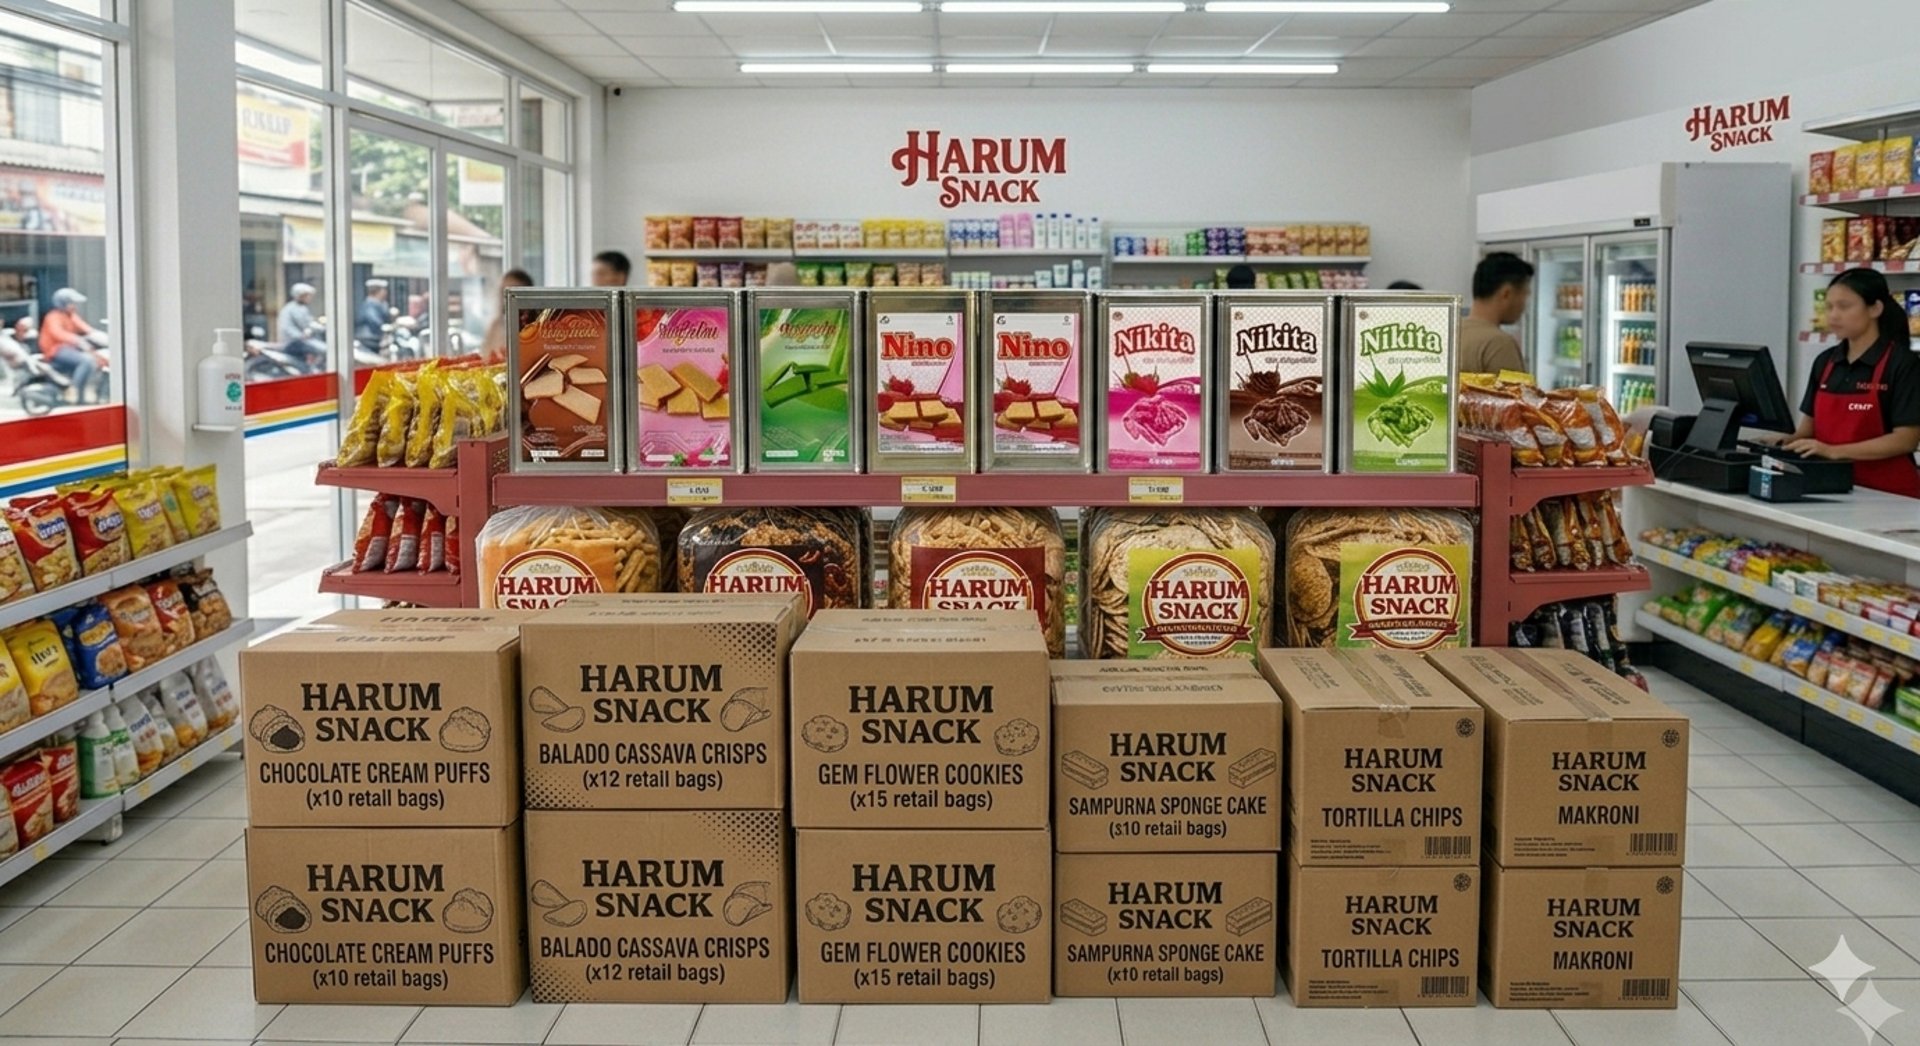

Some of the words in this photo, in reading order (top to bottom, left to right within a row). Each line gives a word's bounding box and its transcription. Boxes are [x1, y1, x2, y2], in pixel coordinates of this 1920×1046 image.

[1685, 95, 1790, 142] HARUM
[1711, 125, 1773, 152] SNACK
[892, 131, 1067, 187] HARUM
[939, 175, 1041, 208] SNACK
[881, 331, 955, 360] Nino
[997, 331, 1072, 360] Nino
[1115, 322, 1196, 356] Nikita
[1236, 322, 1317, 356] Nikita
[1361, 321, 1443, 356] Nikita
[498, 576, 596, 596] HARUM
[709, 575, 805, 593] HARUM
[929, 578, 1028, 598] HARUM
[1150, 580, 1248, 599] HARUM
[1362, 575, 1457, 595] HARUM
[506, 598, 568, 610] SNA
[1158, 602, 1239, 620] SNACK
[580, 665, 722, 692] HARUM
[301, 683, 442, 711] HARUM
[849, 686, 993, 713] HARUM
[594, 698, 711, 723] SNACK
[316, 717, 431, 742] SNACK
[862, 719, 981, 744] SNACK
[540, 743, 609, 764] BALADO
[616, 743, 696, 764] CASSAVA
[702, 743, 767, 764] CRISPS
[1110, 733, 1226, 756] HARUM
[1345, 748, 1442, 768] HARUM
[1552, 751, 1646, 770] HARUM
[260, 762, 361, 783] CHOCOLATE
[367, 762, 428, 783] CREAM
[435, 762, 490, 783] PUFFS
[583, 770, 619, 791] (x12
[676, 771, 722, 791] bags)
[819, 764, 857, 784] GEM
[865, 764, 938, 785] FLOWER
[946, 764, 1023, 785] COOKIES
[1121, 762, 1216, 782] SNACK
[1559, 774, 1639, 791] SNACK
[1352, 774, 1436, 792] SNACK
[307, 789, 342, 810] (x10
[398, 789, 444, 810] bags)
[851, 790, 887, 811] (x15
[945, 791, 992, 811] bags)
[1070, 797, 1156, 815] SAMPURNA
[1161, 797, 1222, 815] SPONGE
[1227, 796, 1266, 814] CAKE
[1322, 808, 1404, 827] TORTILLA
[1411, 807, 1462, 827] CHIPS
[1559, 805, 1639, 824] MAKRONI
[1187, 821, 1226, 838] bags)
[307, 864, 444, 892] HARUM
[582, 860, 724, 887] HARUM
[853, 864, 995, 892] HARUM
[1109, 882, 1222, 904] HARUM
[321, 898, 434, 923] SNACK
[596, 893, 713, 917] SNACK
[866, 898, 984, 922] SNACK
[1346, 895, 1438, 914] HARUM
[1548, 898, 1640, 916] HARUM
[1119, 909, 1212, 929] SNACK
[1352, 918, 1432, 935] SNACK
[1554, 921, 1633, 938] SNACK
[265, 943, 366, 963] CHOCOLATE
[372, 943, 432, 963] CREAM
[439, 943, 494, 964] PUFFS
[541, 937, 611, 958] BALADO
[618, 937, 699, 958] CASSAVA
[705, 937, 769, 958] CRISPS
[821, 942, 860, 963] GEM
[868, 942, 941, 963] FLOWER
[948, 942, 1025, 963] COOKIES
[1068, 944, 1153, 962] SAMPURNA
[1159, 944, 1220, 962] SPONGE
[1225, 944, 1264, 962] CAKE
[1322, 949, 1402, 968] TORTILLA
[1409, 948, 1459, 968] CHIPS
[1554, 951, 1632, 970] MAKRONI
[313, 969, 348, 990] (x10
[402, 969, 448, 991] bags)
[586, 964, 622, 984] (x12
[678, 964, 725, 985] bags)
[854, 969, 890, 989] (x15
[948, 969, 995, 989] bags)
[1185, 966, 1223, 984] bags)
